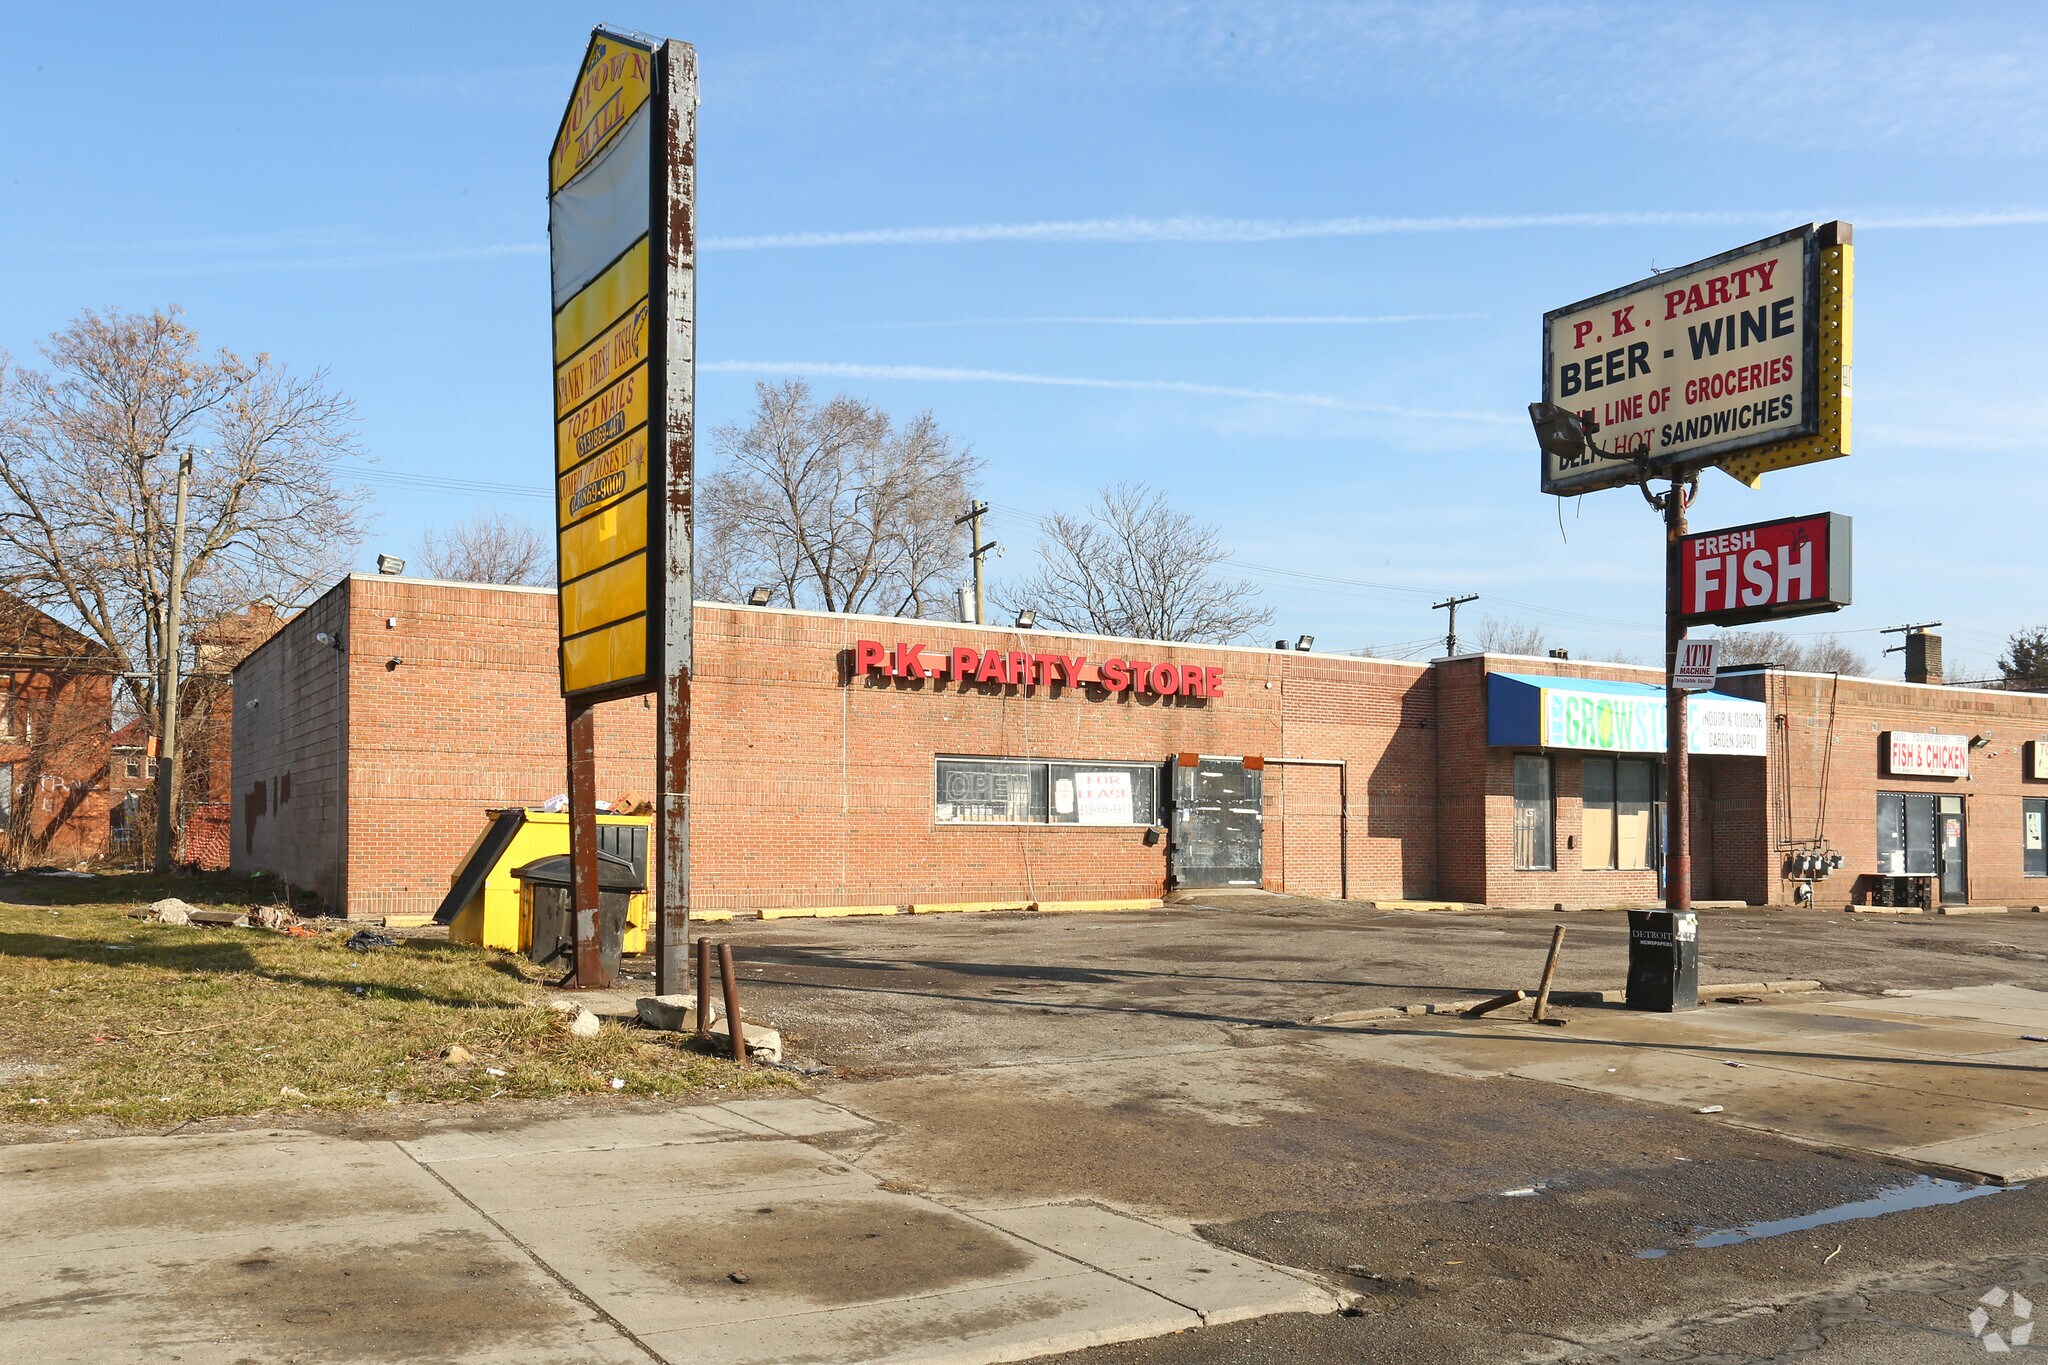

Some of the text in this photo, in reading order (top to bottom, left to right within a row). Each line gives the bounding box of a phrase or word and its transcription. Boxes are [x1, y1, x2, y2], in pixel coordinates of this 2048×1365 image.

[556, 52, 649, 178] MOTOWN
[575, 92, 625, 164] MALL
[1664, 258, 1779, 321] PARTY
[589, 341, 610, 390] FRESH
[614, 323, 632, 370] FISH
[1560, 340, 1652, 398] BEER
[1687, 296, 1795, 361] WINE
[1605, 394, 1643, 427] LINE
[1649, 387, 1671, 415] OF
[1685, 355, 1794, 405] GROCERIES
[567, 408, 588, 443] TOP
[601, 376, 634, 422] NAILS
[1615, 427, 1655, 454] HOT
[1661, 393, 1794, 448] SANDWICHES
[594, 447, 619, 481] ROSES
[1695, 530, 1755, 557] FRESH
[1695, 541, 1813, 614] FISH
[950, 646, 1088, 688] PARTY
[1098, 659, 1224, 698] STORE
[1680, 667, 1710, 675] MACHINE
[1681, 644, 1713, 666] ATM
[1702, 711, 1726, 727] INDOOR
[1735, 712, 1763, 728] OUTDOOR
[1709, 732, 1758, 749] GARDEN SUPPLY
[1892, 742, 1966, 770] FISH & CHICKEN
[1078, 789, 1130, 799] LEASE
[1087, 775, 1120, 785] FOR
[1632, 929, 1673, 940] DETROIT
[1640, 940, 1673, 948] NEWSPAPERS
